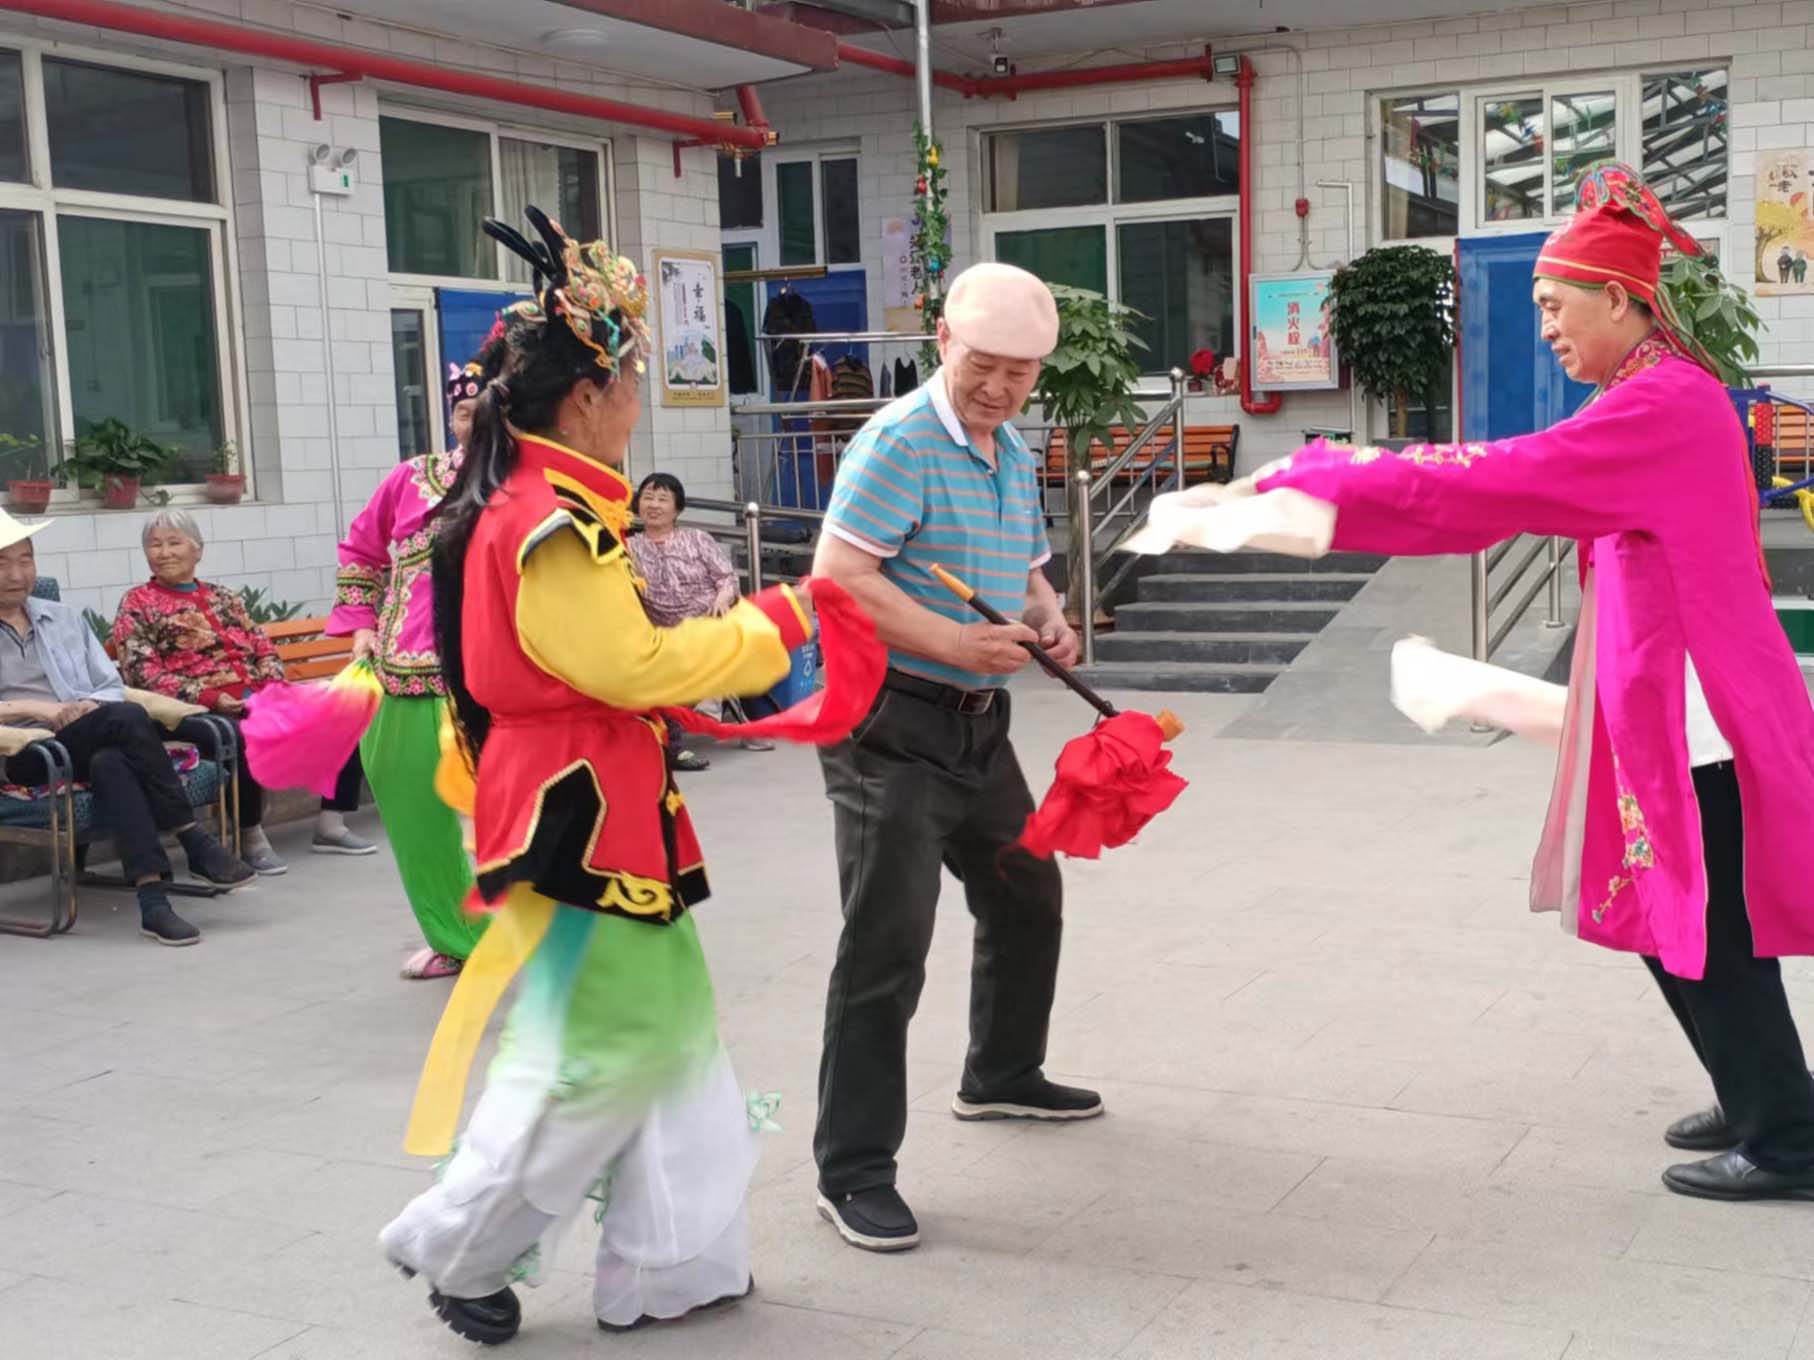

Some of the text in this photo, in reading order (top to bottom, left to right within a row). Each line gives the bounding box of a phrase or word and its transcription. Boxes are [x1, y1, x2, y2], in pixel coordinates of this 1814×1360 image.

[692, 282, 706, 322] 幸福
[1287, 302, 1300, 345] 消火栓
